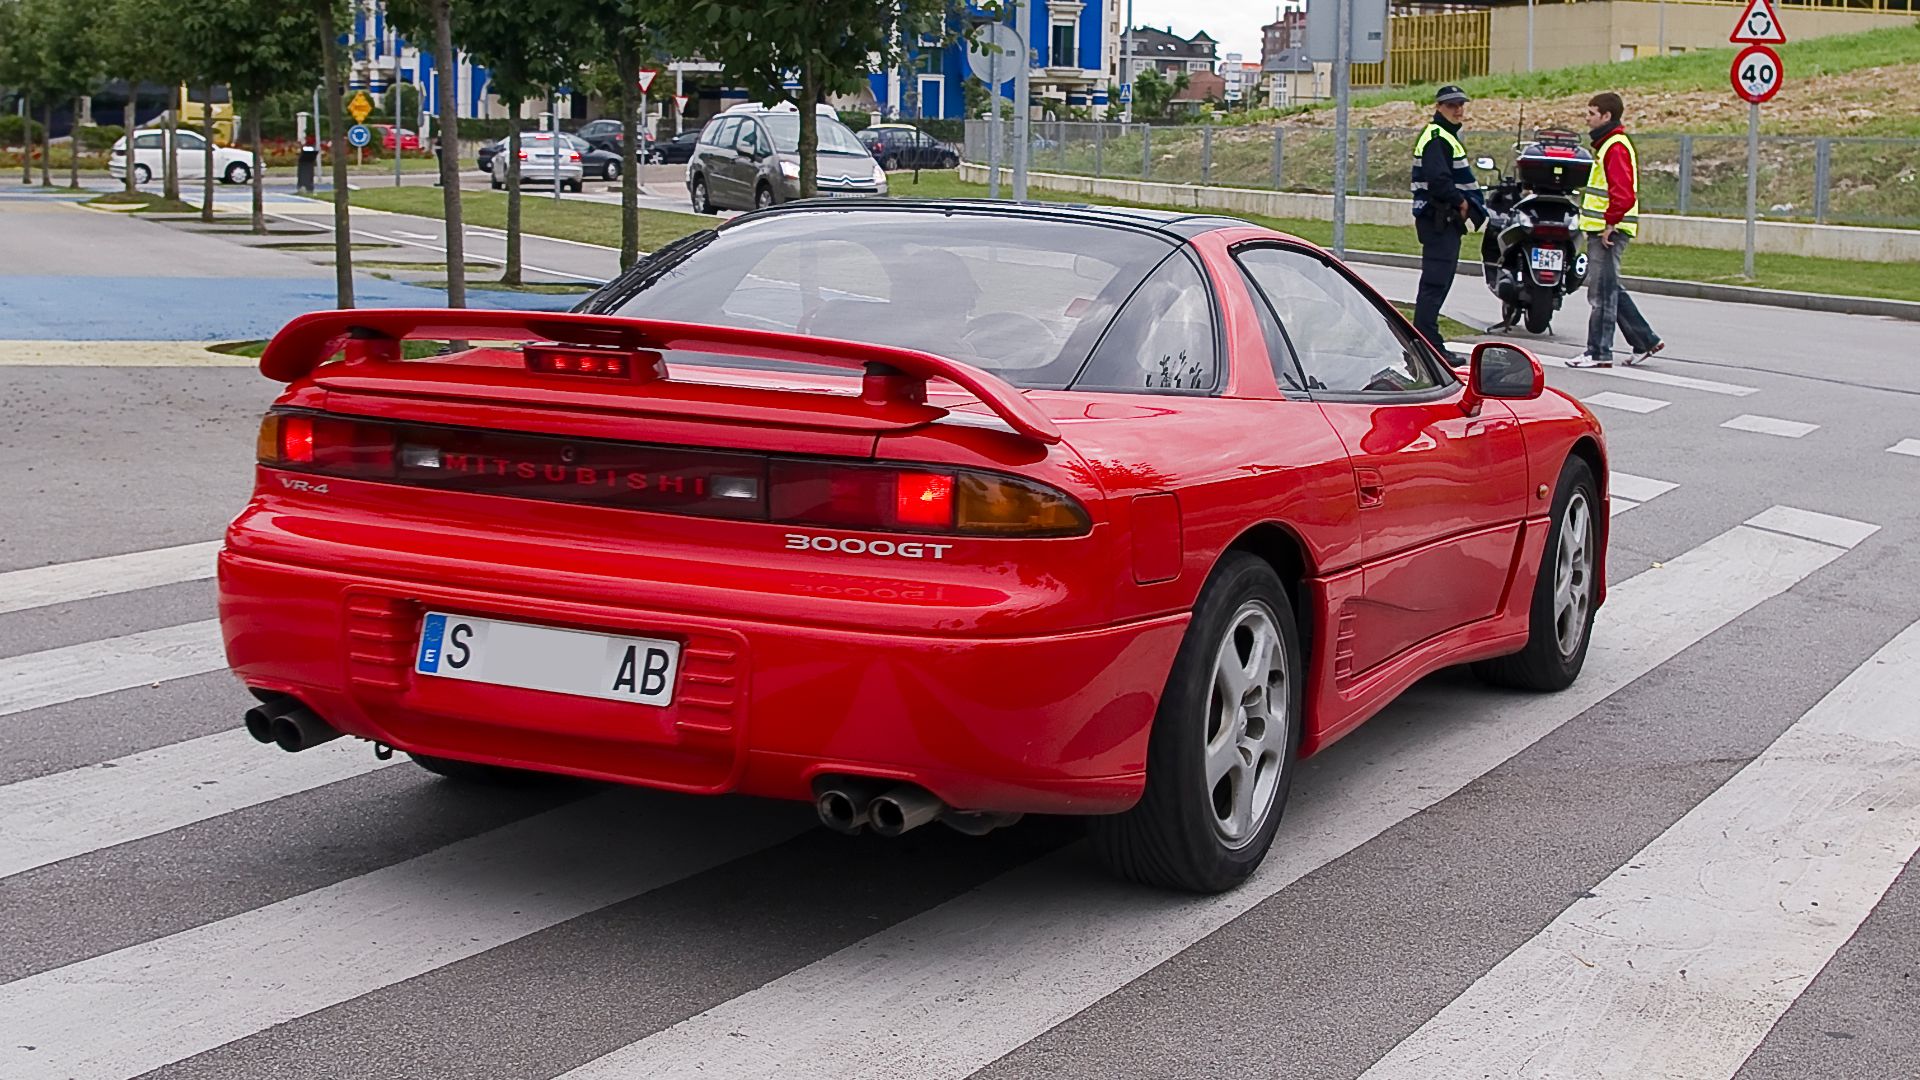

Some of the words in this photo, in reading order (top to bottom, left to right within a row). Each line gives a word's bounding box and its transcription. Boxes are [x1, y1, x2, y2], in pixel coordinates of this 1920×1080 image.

[1742, 65, 1773, 84] 40
[445, 453, 704, 495] MITSUBISHI
[281, 478, 328, 493] VR-4
[785, 533, 953, 559] 3000GT
[424, 649, 437, 663] E
[446, 624, 474, 669] S
[612, 645, 670, 696] AB
